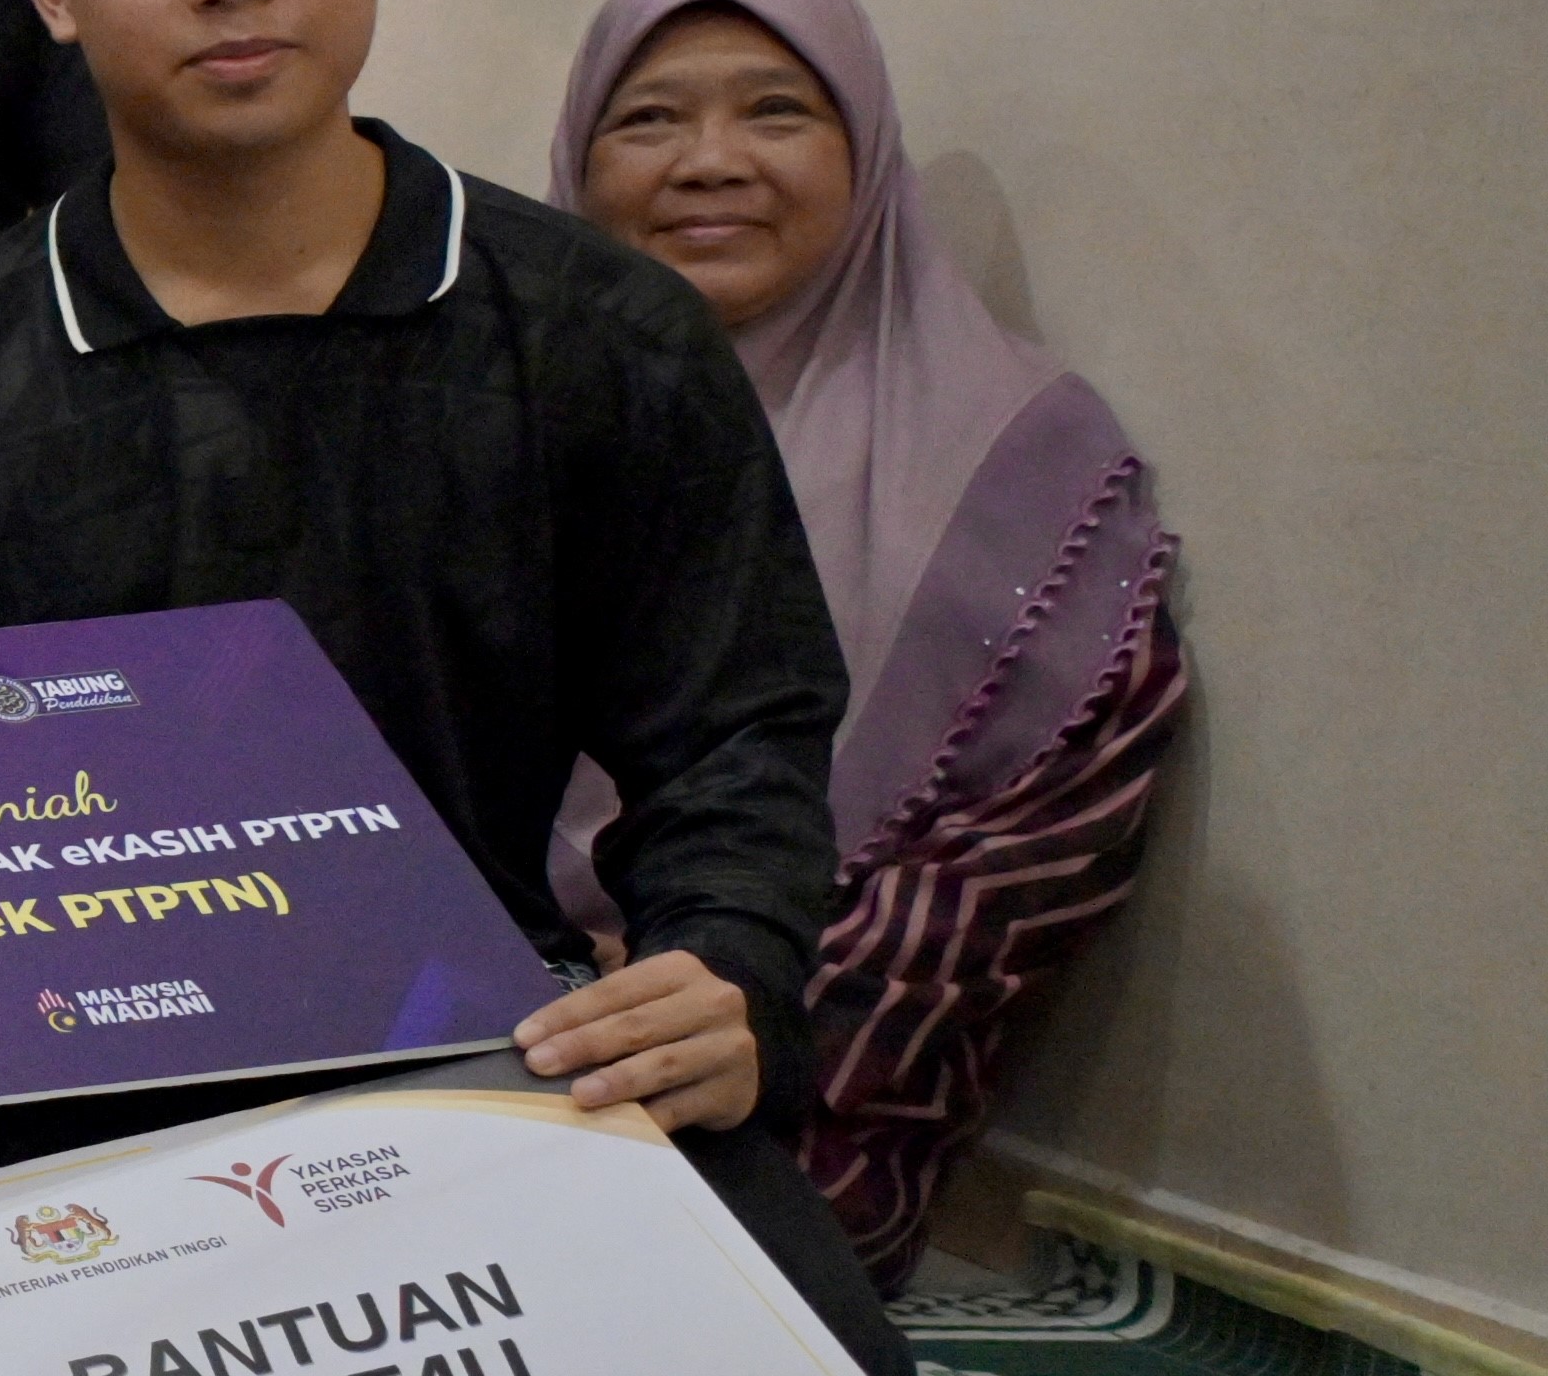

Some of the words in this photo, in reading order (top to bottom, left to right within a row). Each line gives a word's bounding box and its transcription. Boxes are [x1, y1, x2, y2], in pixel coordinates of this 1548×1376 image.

[30, 673, 125, 699] TABUNG
[42, 691, 133, 711] Pendidikan
[59, 823, 235, 871] eKASIH
[239, 802, 402, 847] PTPTN
[58, 870, 290, 931] PTPTN)
[75, 979, 204, 1007] MALAYSIA
[83, 993, 216, 1026] MADANI
[289, 1145, 401, 1180] YAYASAN
[301, 1163, 411, 1198] PERKASA
[314, 1186, 392, 1213] SISWA
[70, 1248, 170, 1282] PENDIDIKAN
[170, 1234, 229, 1258] TINGGI
